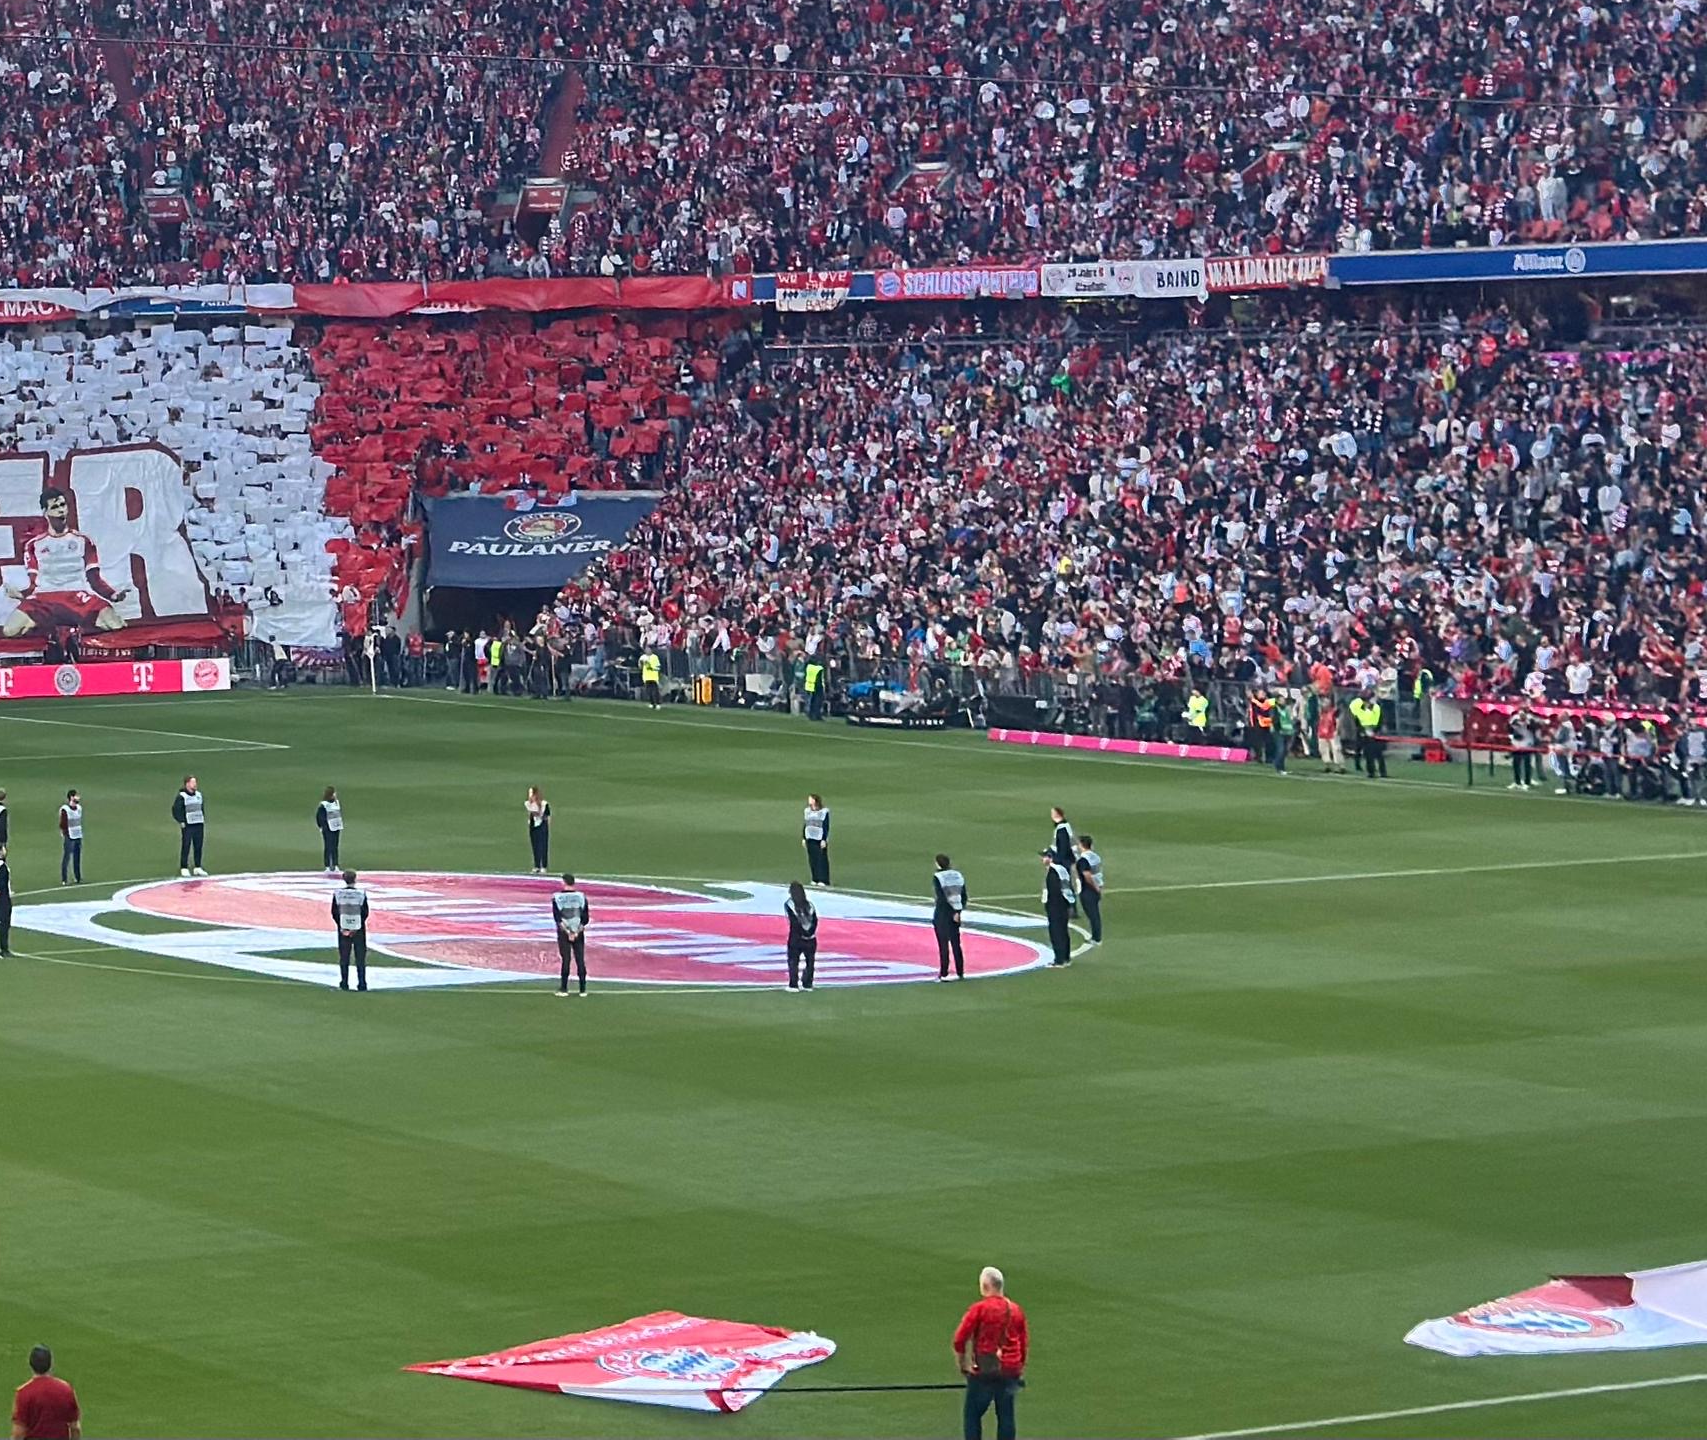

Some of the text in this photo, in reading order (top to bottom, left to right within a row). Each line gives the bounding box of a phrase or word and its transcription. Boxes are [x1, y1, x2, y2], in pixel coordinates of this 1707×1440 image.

[1513, 253, 1564, 272] Allianz
[1156, 269, 1200, 289] BAIND
[448, 539, 613, 556] PAULANER
